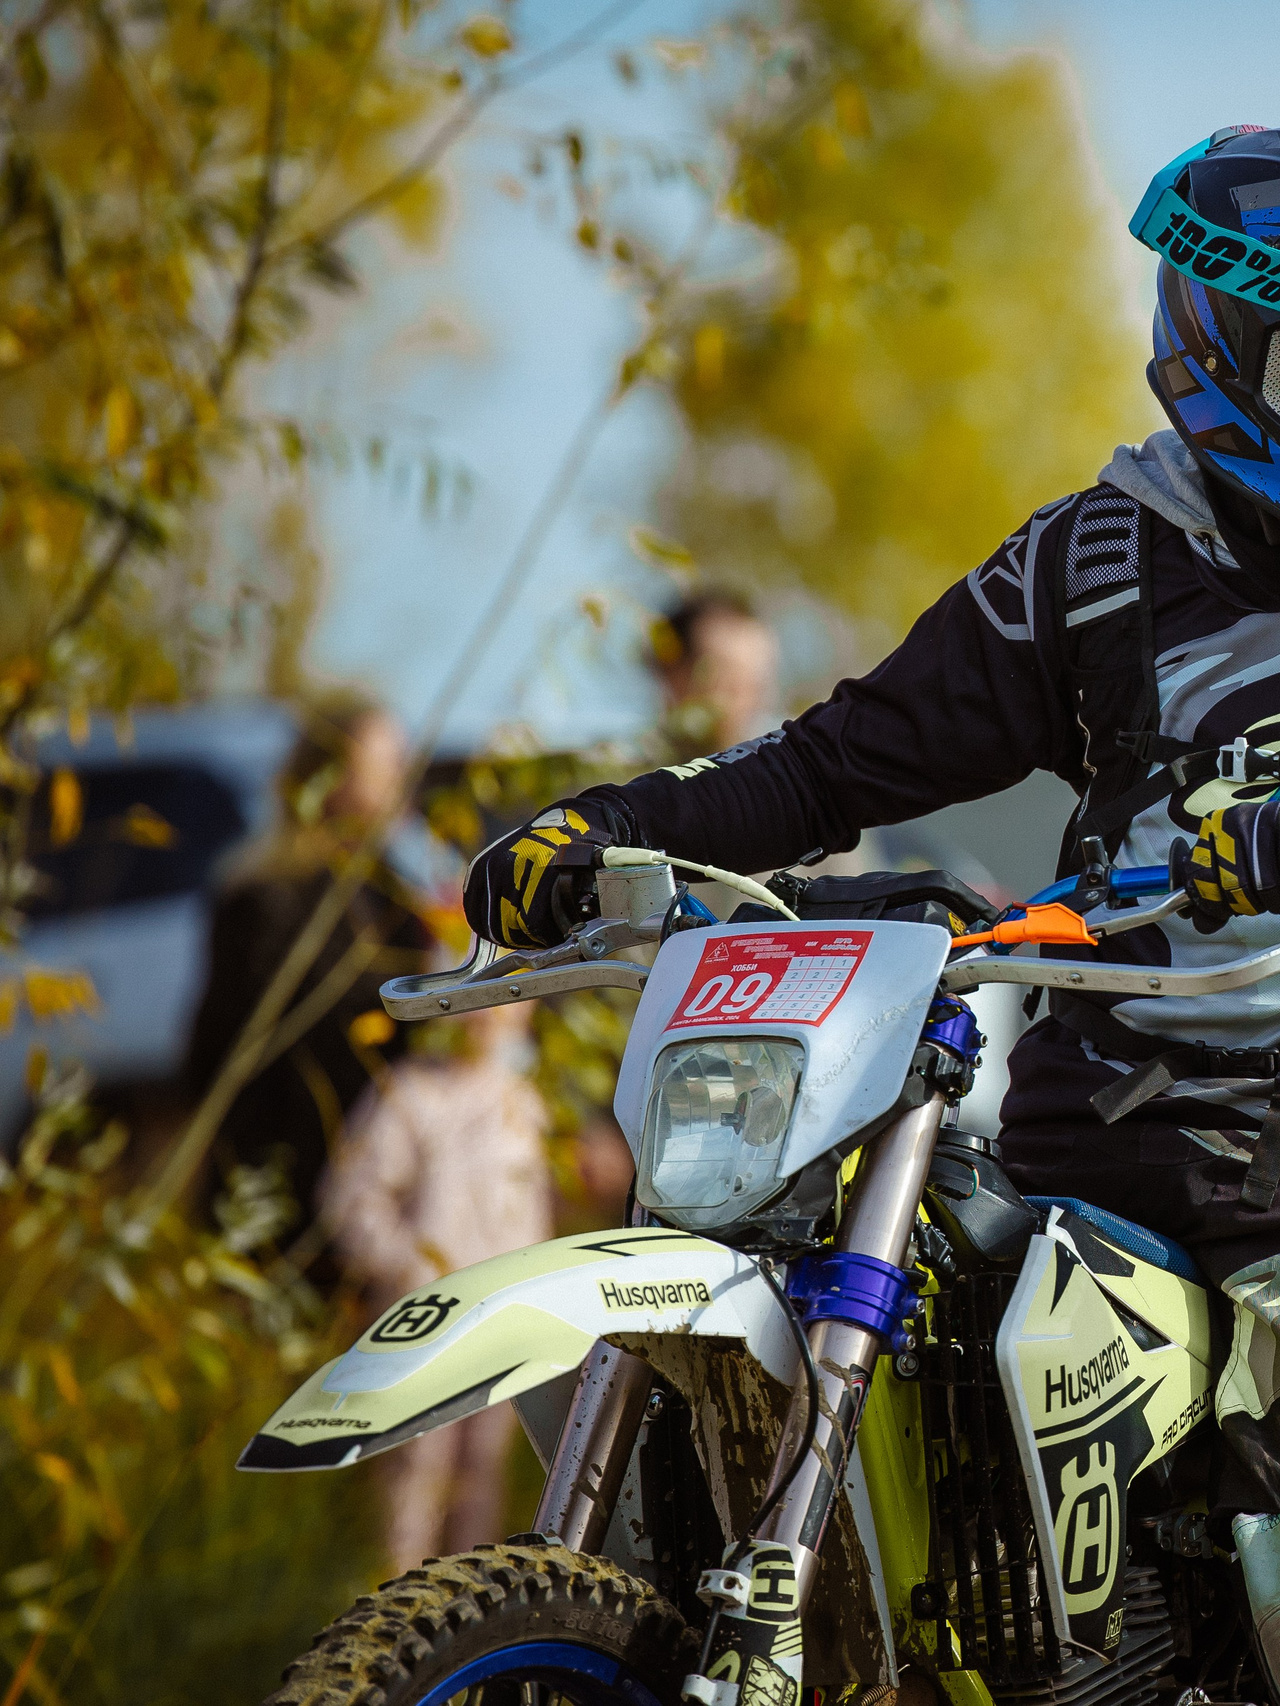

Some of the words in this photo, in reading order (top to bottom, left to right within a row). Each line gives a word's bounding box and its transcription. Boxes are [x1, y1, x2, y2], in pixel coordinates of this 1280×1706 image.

[731, 963, 758, 972] ХОББИ
[798, 959, 805, 967] 1
[683, 972, 773, 1017] 09
[601, 1282, 711, 1310] Husqvarna
[1045, 1335, 1130, 1413] Husqvarna
[273, 1417, 372, 1431] Husqvarna
[1161, 1415, 1178, 1450] PRO
[1179, 1385, 1214, 1431] CIRCUIT
